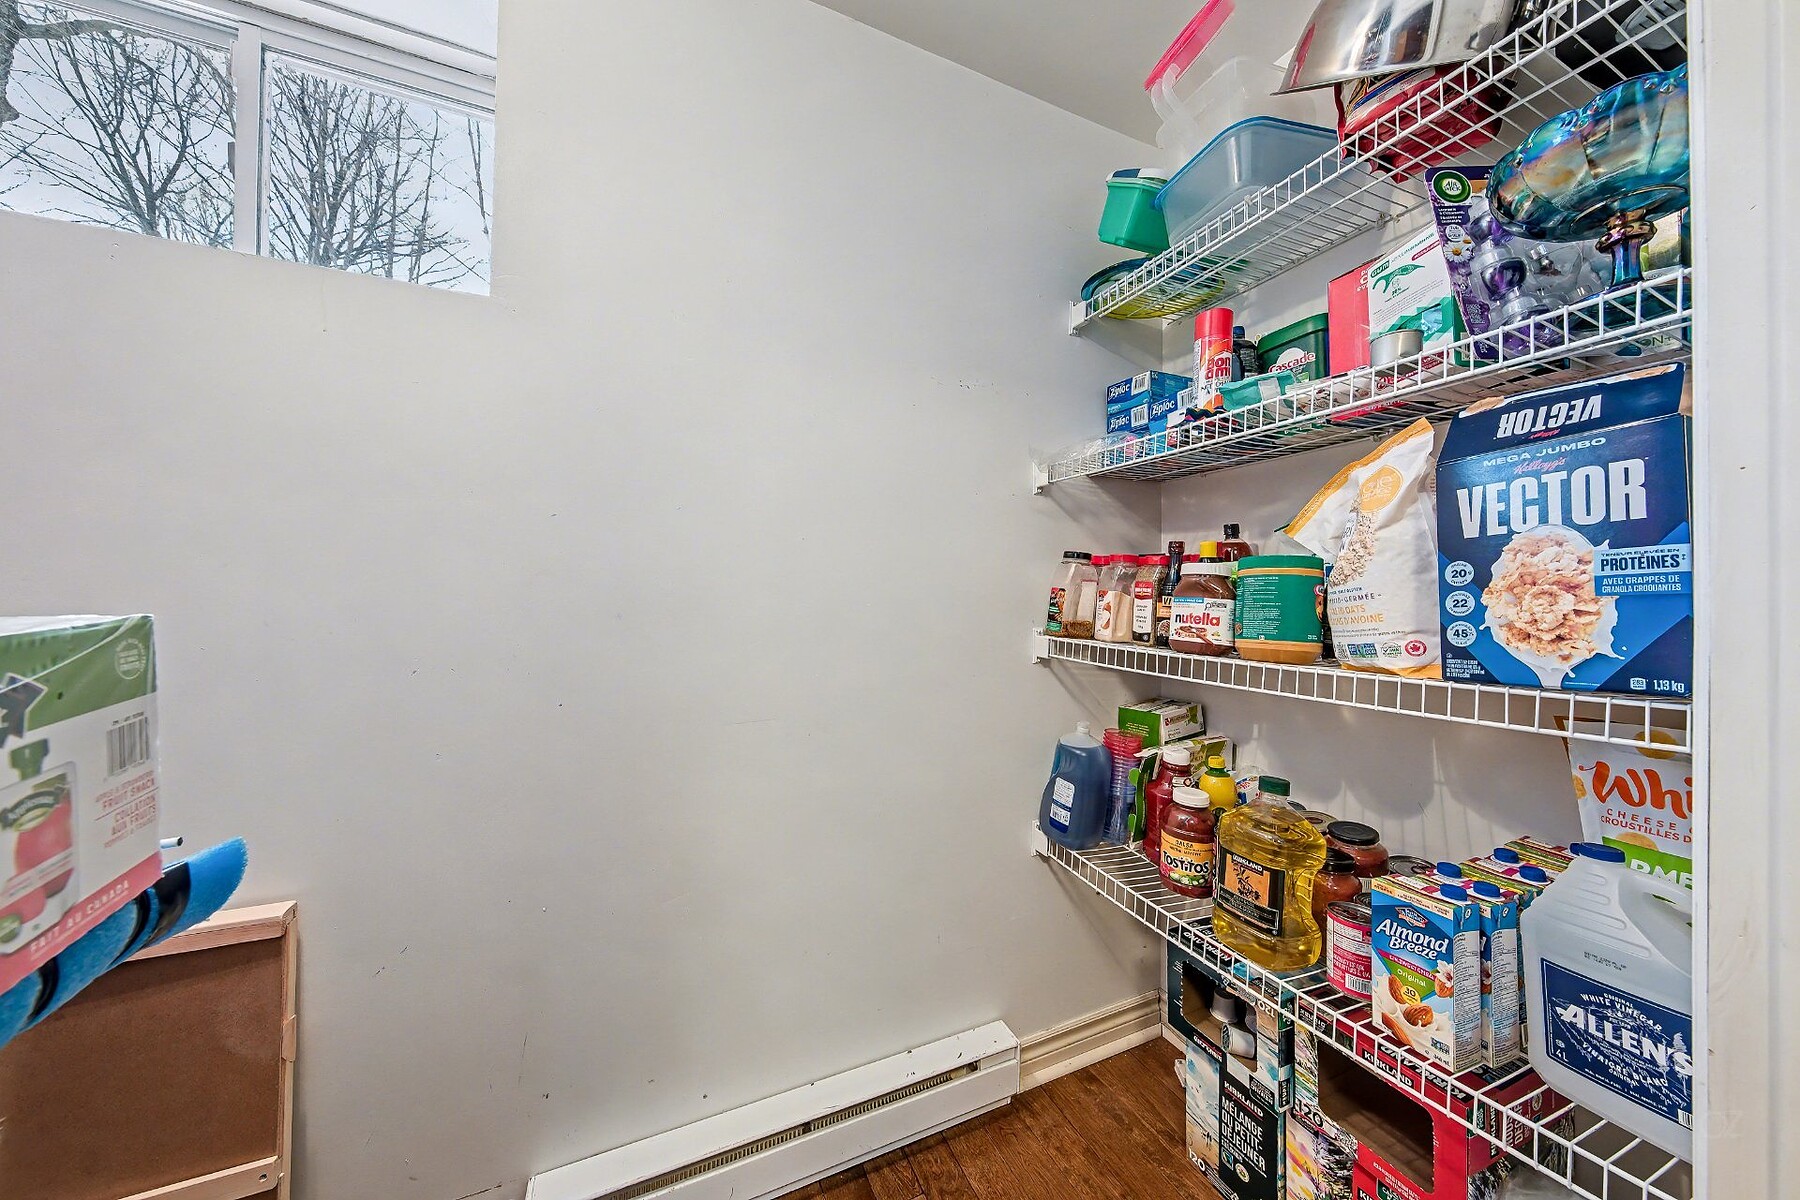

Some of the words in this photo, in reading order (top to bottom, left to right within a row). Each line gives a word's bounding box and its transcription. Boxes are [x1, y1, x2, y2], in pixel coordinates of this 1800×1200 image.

[1268, 351, 1316, 373] Cascade
[1109, 383, 1131, 399] Ziploc
[1151, 399, 1176, 418] Ziploc
[1496, 394, 1602, 439] VECTOR
[1109, 415, 1130, 431] Ziploc
[1484, 453, 1531, 467] MEGA
[1536, 437, 1607, 457] JUMBO
[1456, 458, 1648, 539] VECTOR
[1451, 569, 1467, 579] 20
[1603, 577, 1623, 585] AVEC
[1625, 575, 1666, 584] GRAPPES
[1670, 574, 1680, 583] DE
[1602, 585, 1632, 594] GRANOLA
[1634, 583, 1682, 593] CROQUANTES
[1452, 598, 1469, 608] 22
[1175, 612, 1221, 627] nutella
[1453, 629, 1469, 638] 45
[1653, 679, 1670, 692] 1,13
[1671, 680, 1685, 693] kg
[1600, 815, 1680, 842] CROUSTILLES
[1607, 808, 1677, 831] CHEESE
[1175, 839, 1194, 849] SALSA
[1375, 919, 1450, 954] Almond
[1389, 936, 1437, 960] Breeze
[1404, 986, 1416, 997] 30
[1603, 992, 1634, 1009] ORIGINAL
[1256, 998, 1276, 1019] 120
[1580, 993, 1611, 1007] WHITE
[1614, 1001, 1662, 1032] VINEGAR
[1555, 1003, 1692, 1077] ALLEN'S
[1364, 1051, 1414, 1087] KIRKLAND
[1582, 1042, 1629, 1076] VINAIGRE
[1379, 1045, 1467, 1100] KIRKLAND
[1223, 1080, 1264, 1118] KIRKLAND
[1221, 1096, 1264, 1141] MÉLANGE
[1221, 1109, 1234, 1128] DU
[1221, 1123, 1266, 1172] DÉJEUNER
[1189, 1147, 1207, 1173] 120
